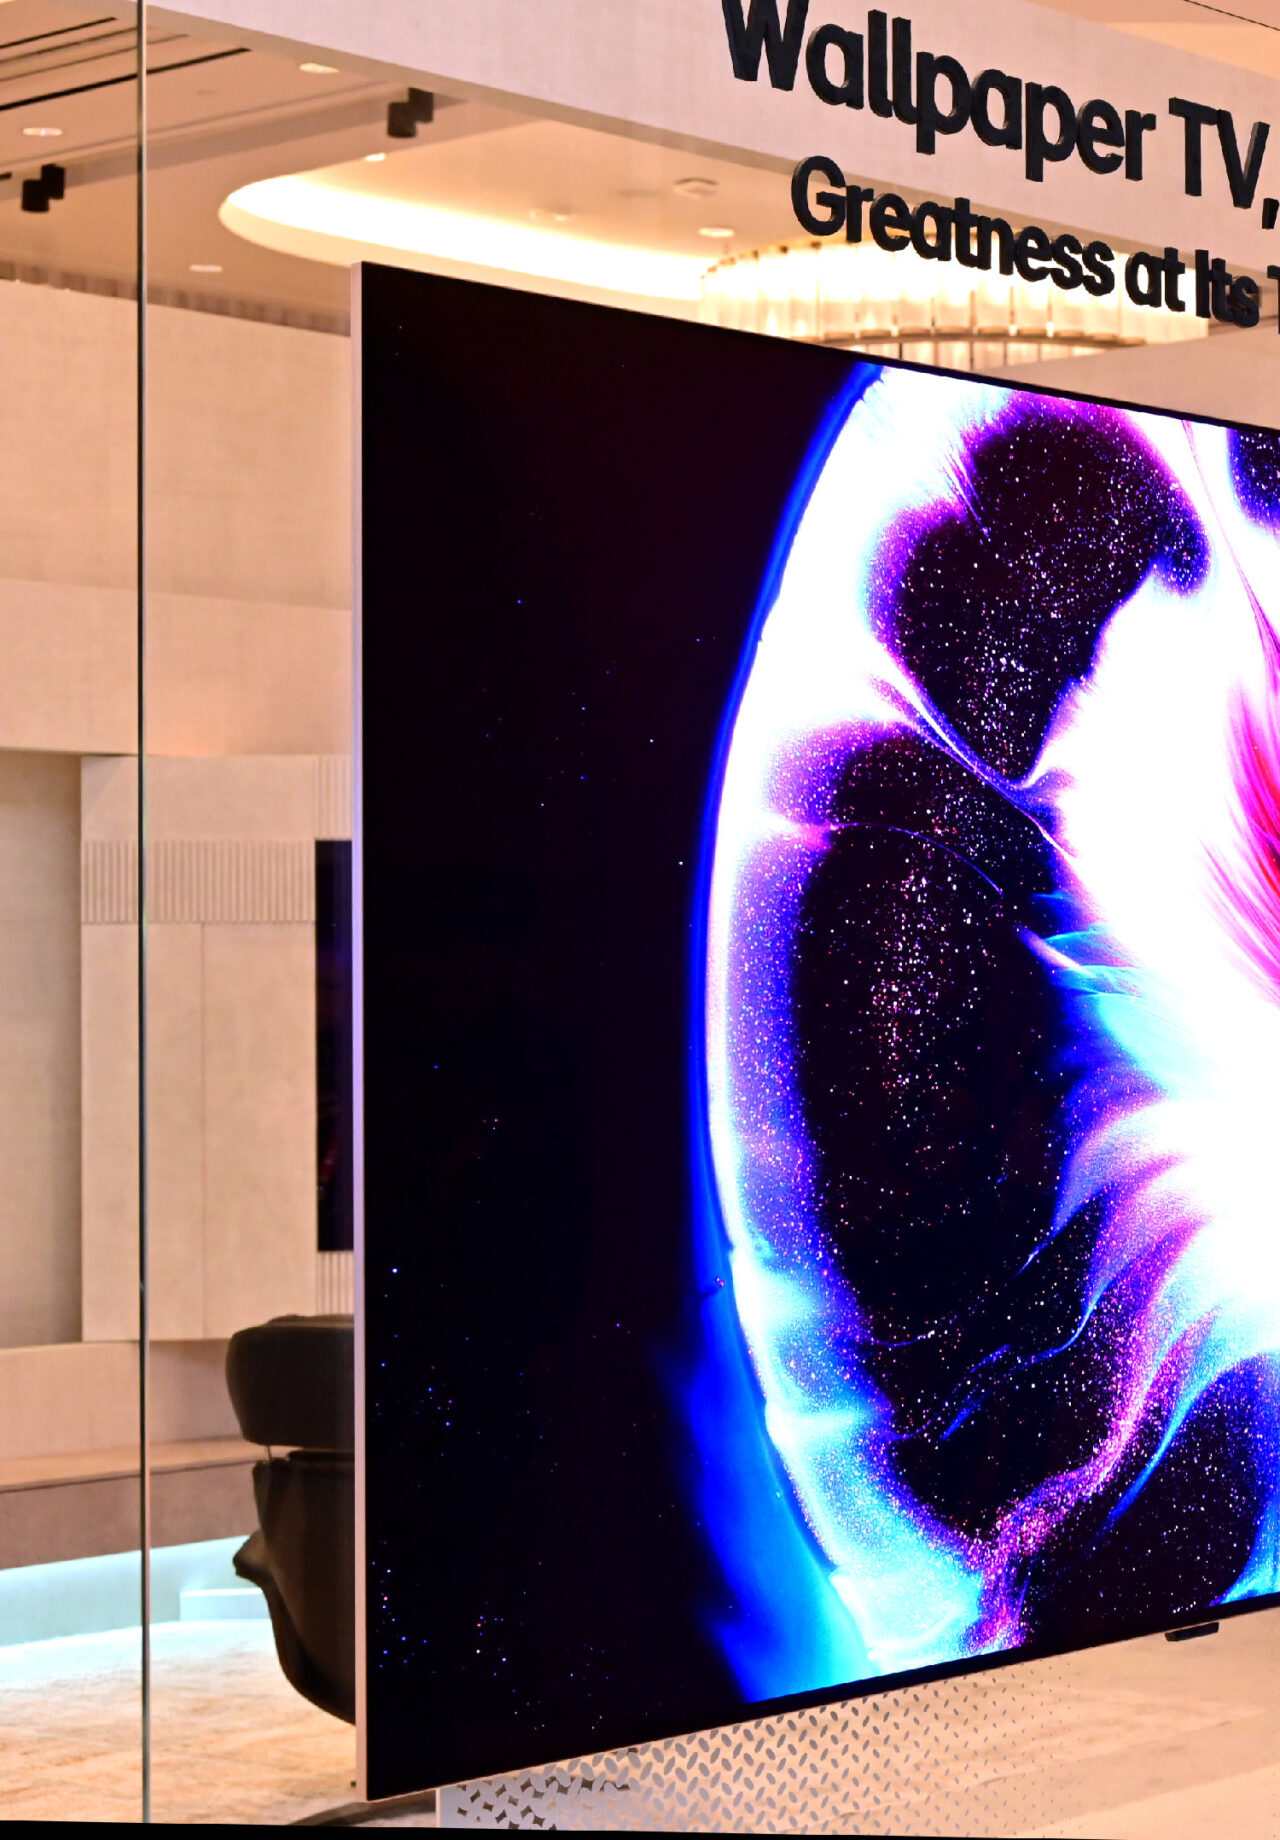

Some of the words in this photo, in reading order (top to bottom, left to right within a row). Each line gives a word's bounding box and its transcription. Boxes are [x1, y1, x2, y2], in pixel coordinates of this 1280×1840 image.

[721, 0, 1157, 183] Wallpaper
[1168, 97, 1280, 230] TV,
[790, 155, 1116, 297] Greatness
[1125, 246, 1186, 312] at
[1195, 248, 1262, 328] Its
